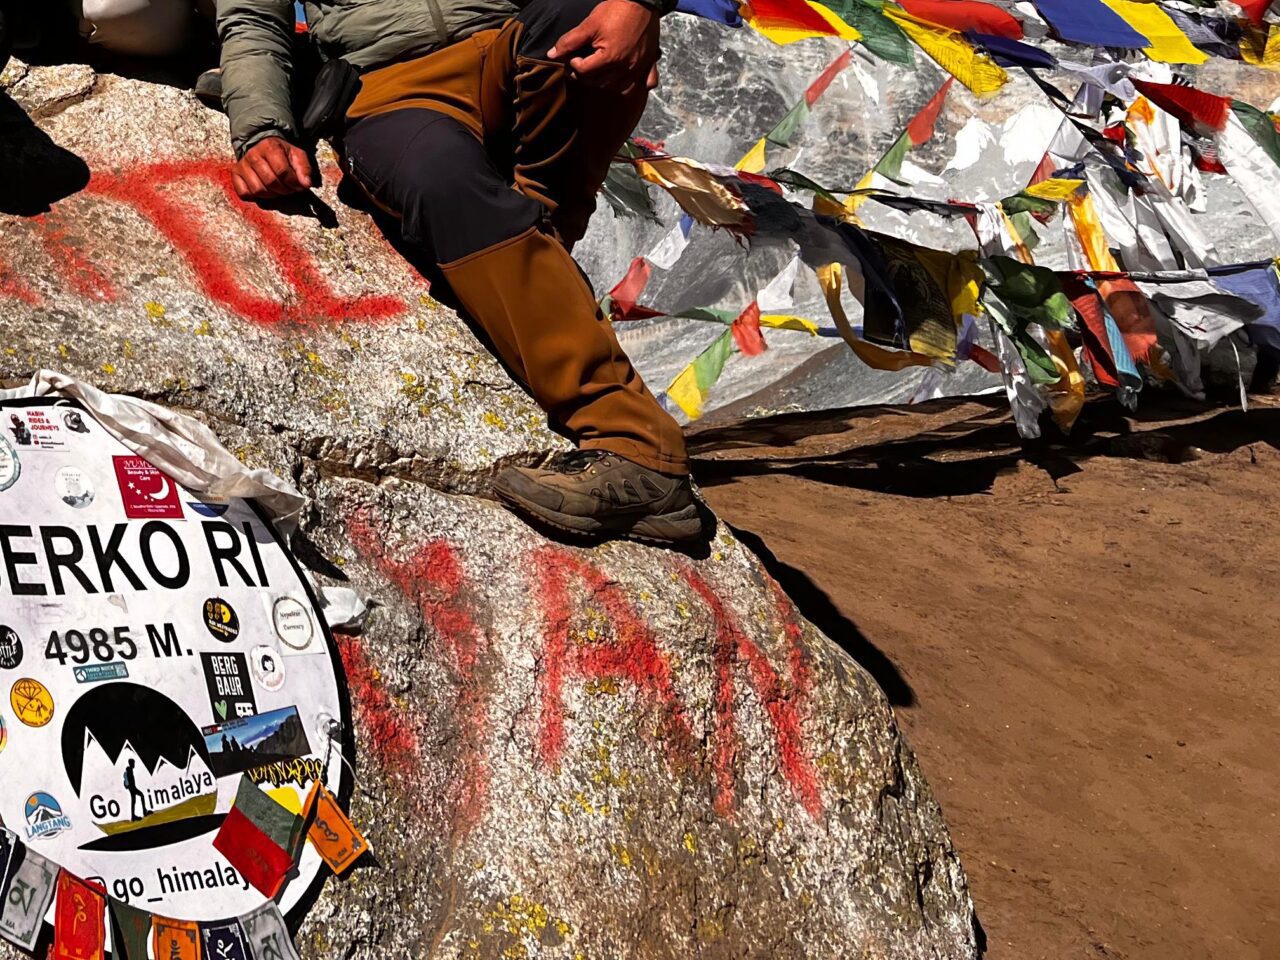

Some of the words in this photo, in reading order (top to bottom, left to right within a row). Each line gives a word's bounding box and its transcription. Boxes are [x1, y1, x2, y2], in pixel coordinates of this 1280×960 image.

[201, 520, 270, 588] RI
[45, 626, 138, 665] 4985
[146, 623, 194, 658] M.
[211, 655, 239, 675] BERG
[215, 676, 244, 696] BAUR
[90, 794, 121, 819] Go
[25, 816, 71, 839] LANGTANG
